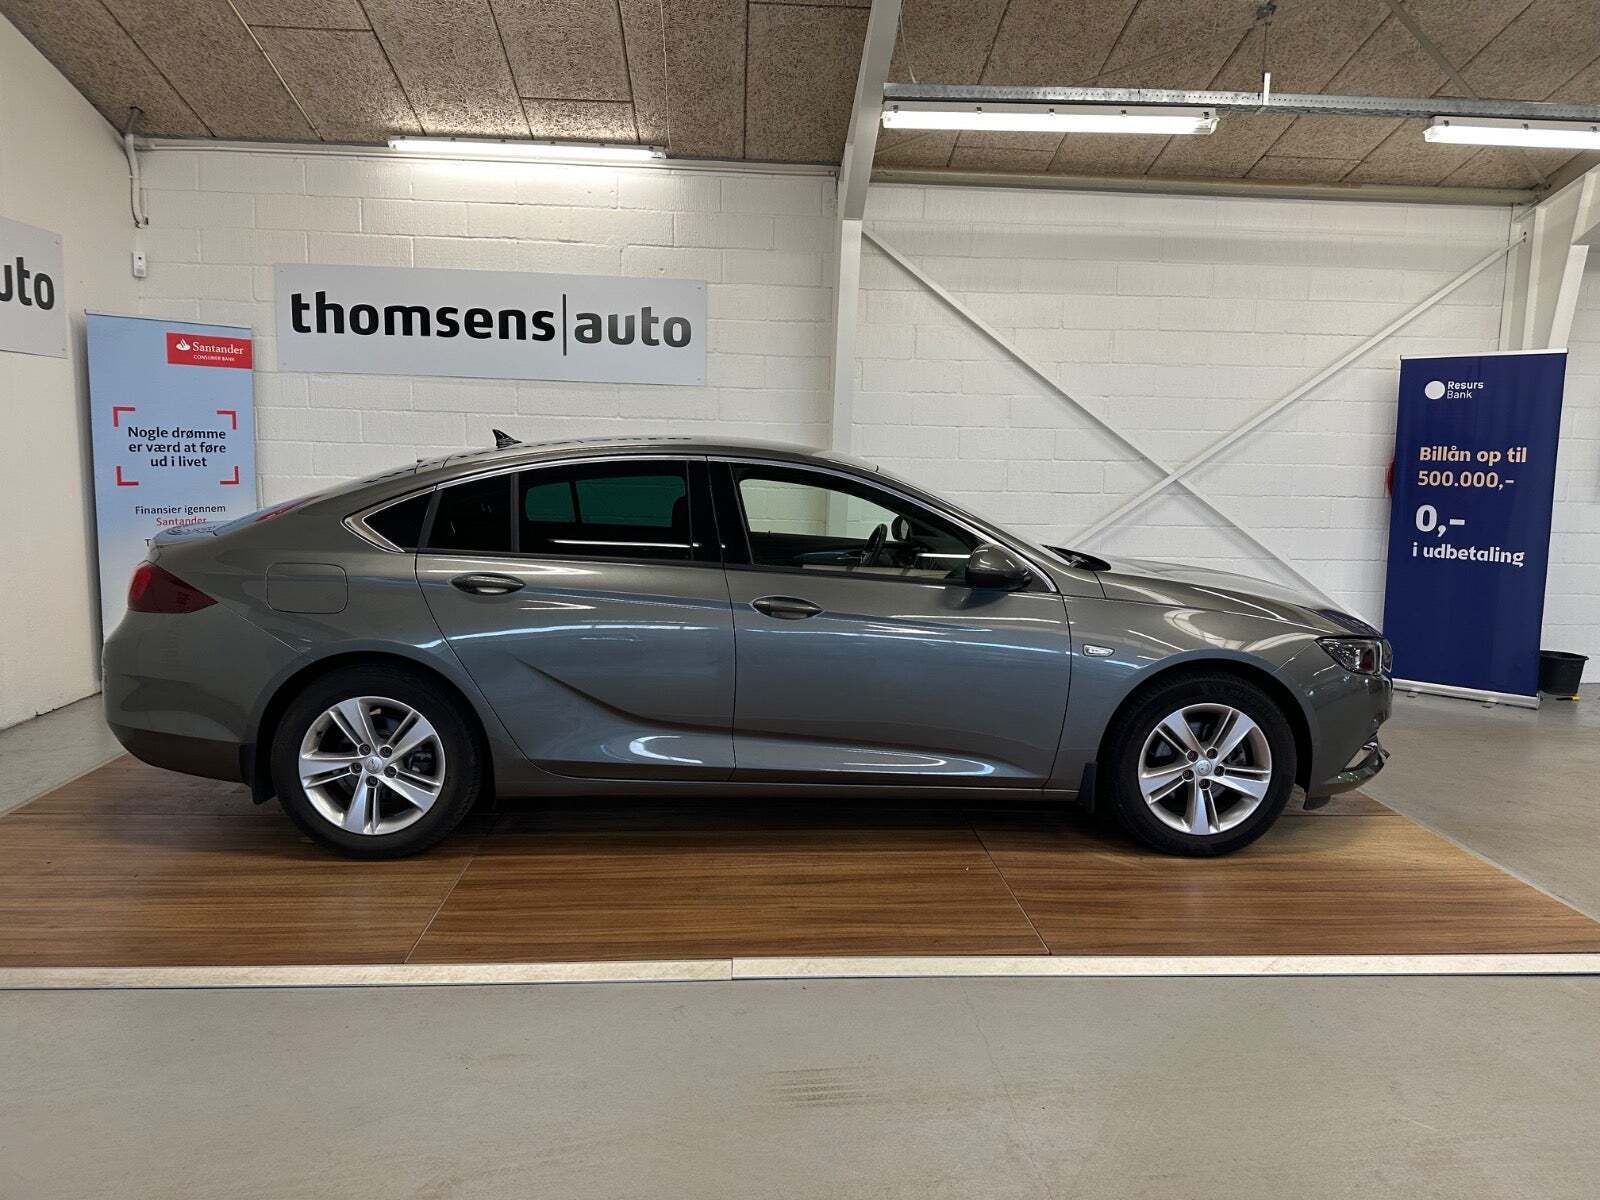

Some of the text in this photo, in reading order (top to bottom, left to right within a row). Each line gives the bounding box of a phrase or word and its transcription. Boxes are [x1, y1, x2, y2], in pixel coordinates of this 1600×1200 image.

[574, 306, 691, 348] auto
[192, 341, 244, 354] Santander
[1447, 381, 1484, 390] Resurs
[1447, 390, 1472, 400] Bank
[128, 426, 226, 441] Nogle drømme
[128, 441, 226, 454] er værd at føre
[150, 456, 208, 468] ud i livet
[1419, 446, 1528, 466] Billån op til
[135, 504, 226, 516] Finansier igennem
[1412, 542, 1526, 568] i udbetaling
